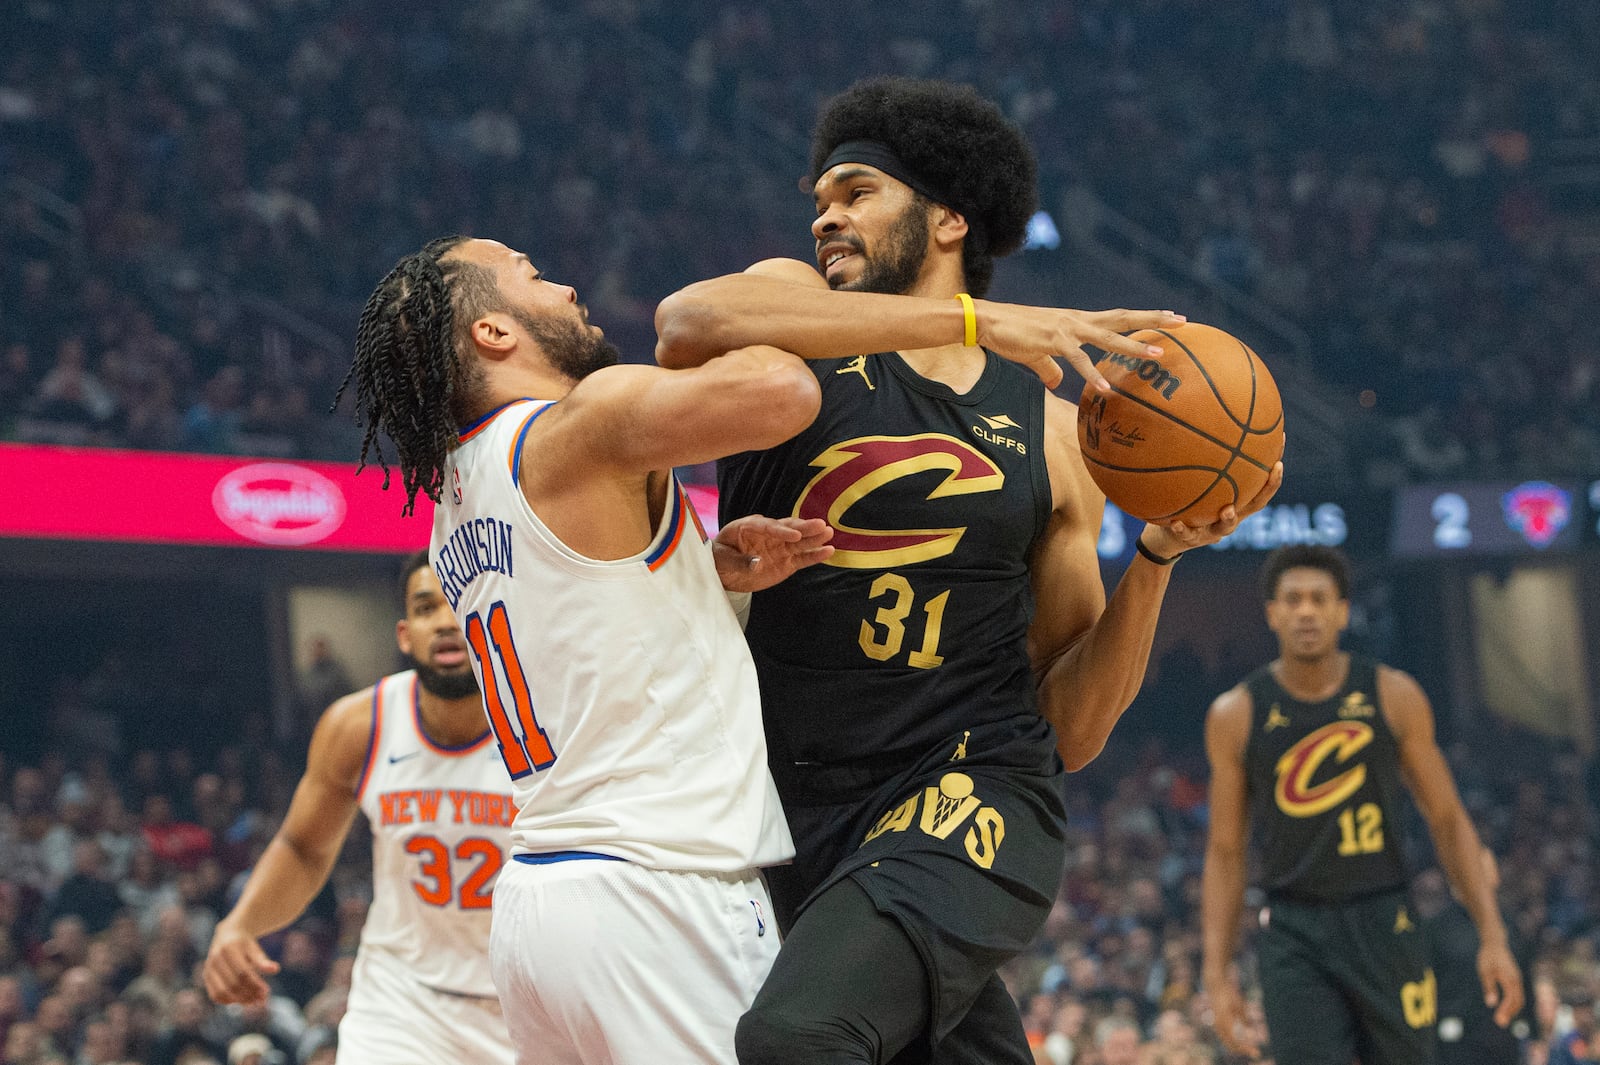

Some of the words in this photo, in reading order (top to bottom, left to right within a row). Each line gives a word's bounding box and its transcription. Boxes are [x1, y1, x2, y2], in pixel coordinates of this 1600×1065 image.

[972, 425, 1027, 456] CLIFFS
[792, 433, 1005, 569] C
[1431, 492, 1473, 549] 2
[435, 517, 513, 613] BRUNSON
[858, 572, 951, 670] 31
[466, 600, 558, 781] 11
[378, 789, 443, 826] NEW
[1274, 720, 1374, 818] C
[404, 834, 504, 911] 32
[1337, 802, 1385, 857] 12
